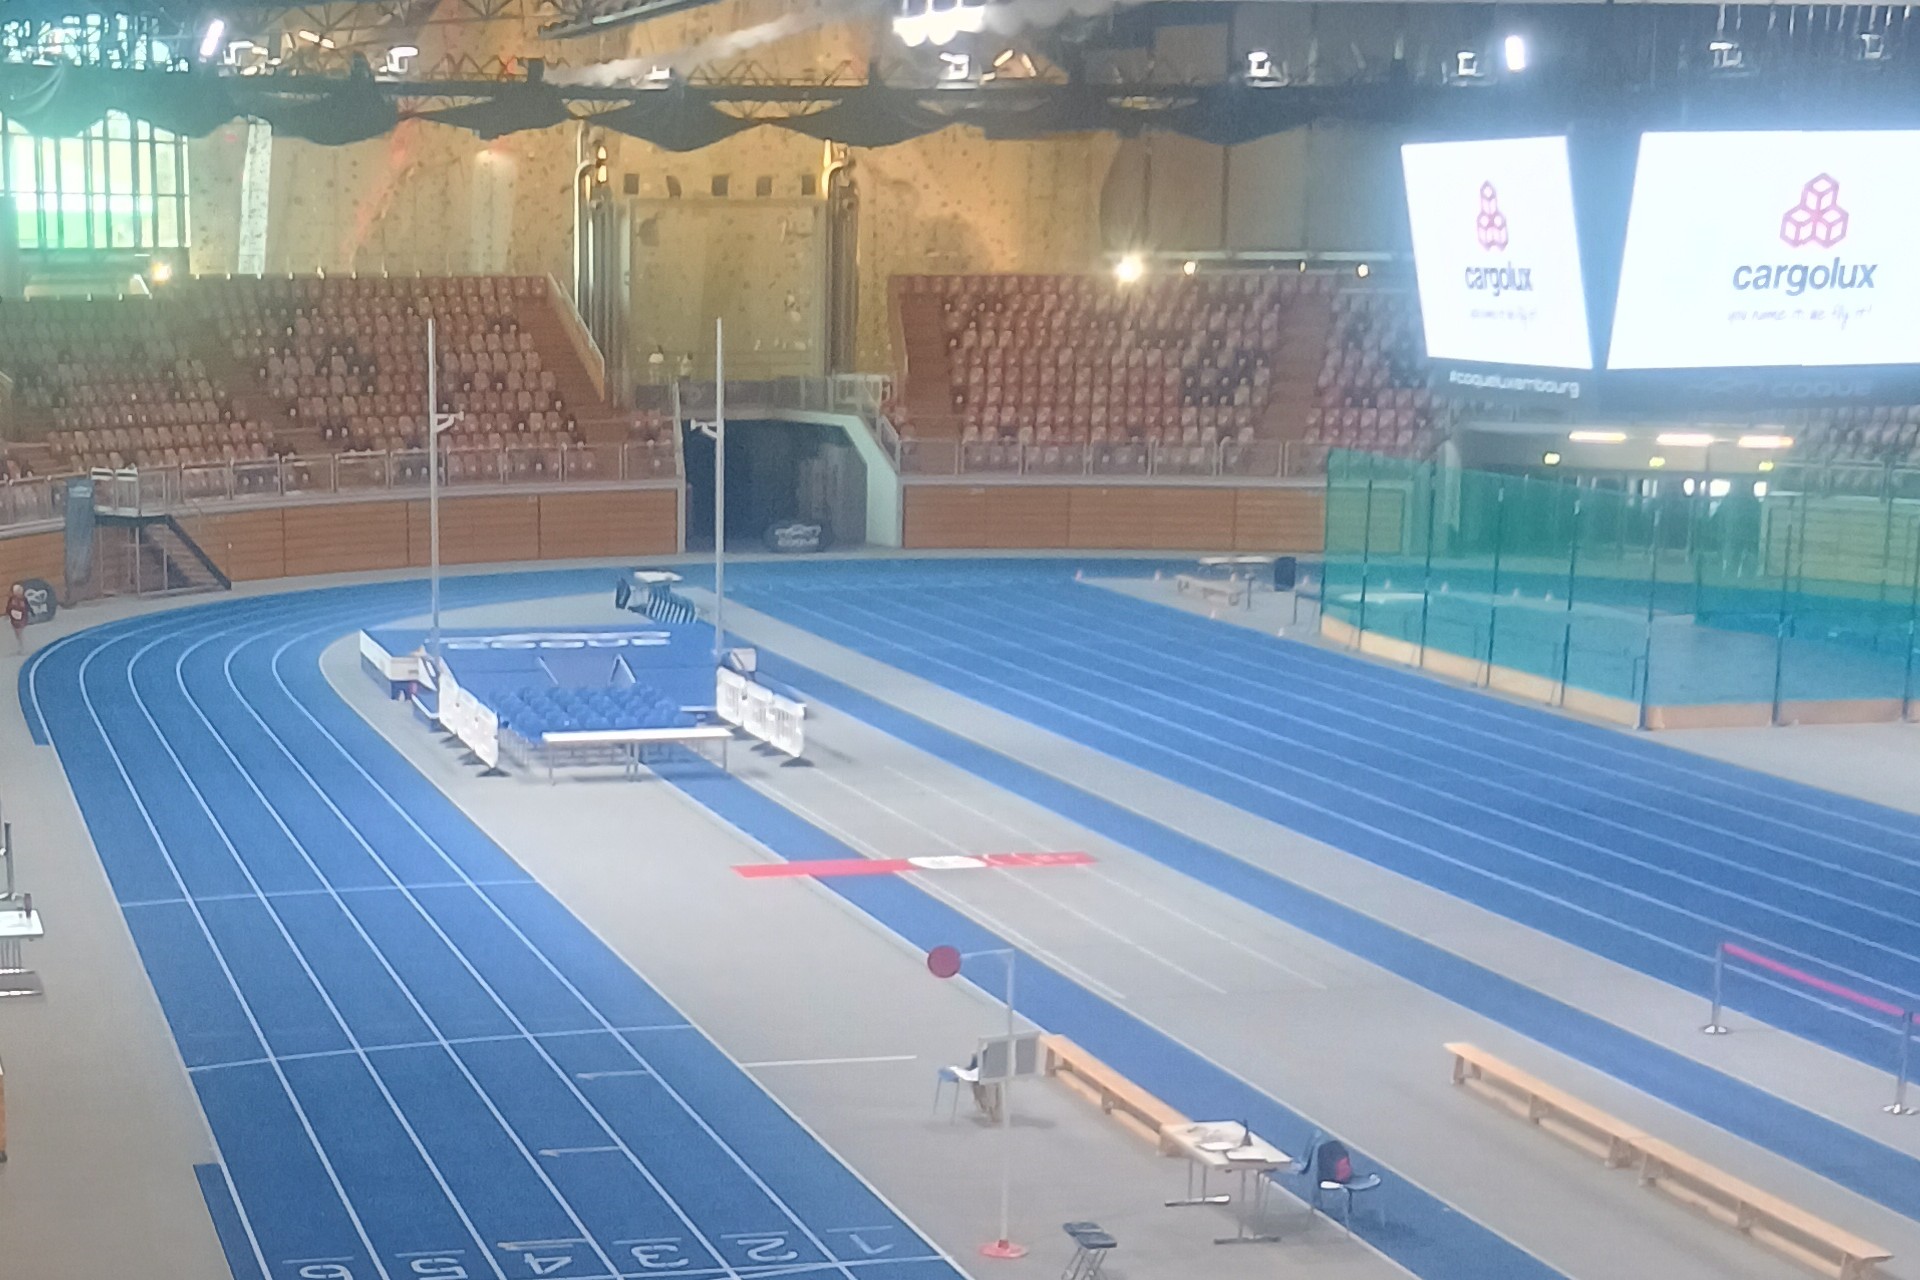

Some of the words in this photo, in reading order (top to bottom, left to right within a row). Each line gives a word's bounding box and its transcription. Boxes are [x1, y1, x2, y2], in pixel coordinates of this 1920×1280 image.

[1465, 261, 1533, 296] cargolux
[1732, 257, 1878, 296] cargolux
[737, 1238, 798, 1261] 2
[849, 1234, 894, 1254] 1
[524, 1253, 572, 1275] 4
[631, 1245, 689, 1268] 3
[410, 1258, 468, 1280] 5
